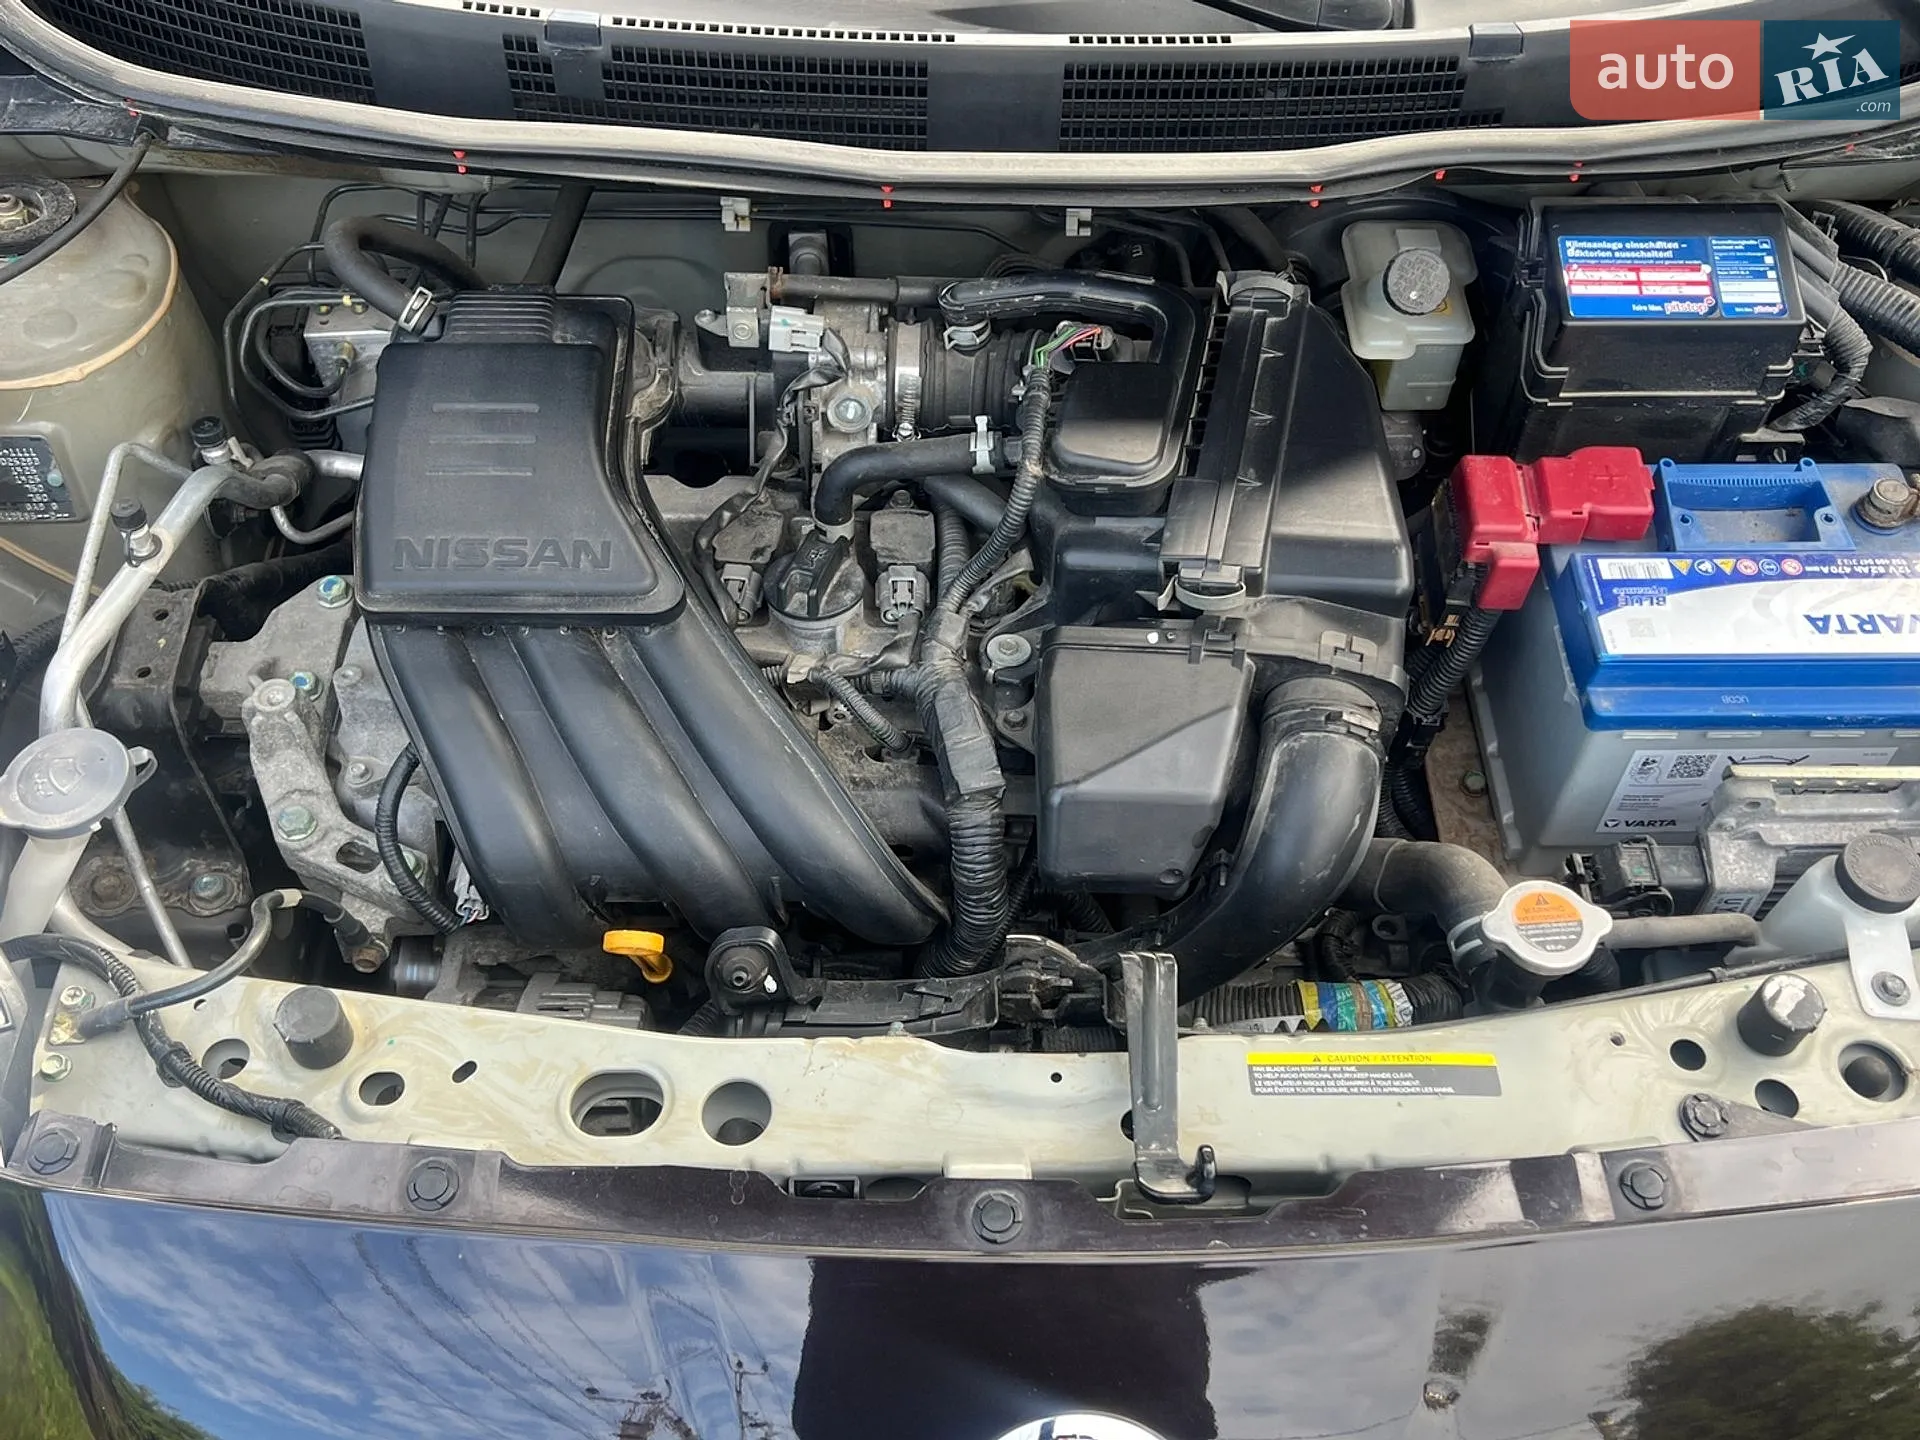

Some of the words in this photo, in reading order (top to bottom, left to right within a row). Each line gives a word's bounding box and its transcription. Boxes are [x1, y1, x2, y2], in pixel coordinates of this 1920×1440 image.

[392, 535, 613, 571] NISSAN
[1617, 595, 1667, 608] BLUE
[1624, 819, 1677, 828] VARTA
[1327, 1054, 1370, 1063] CAUTION
[1379, 1054, 1433, 1063] ATTENTION
